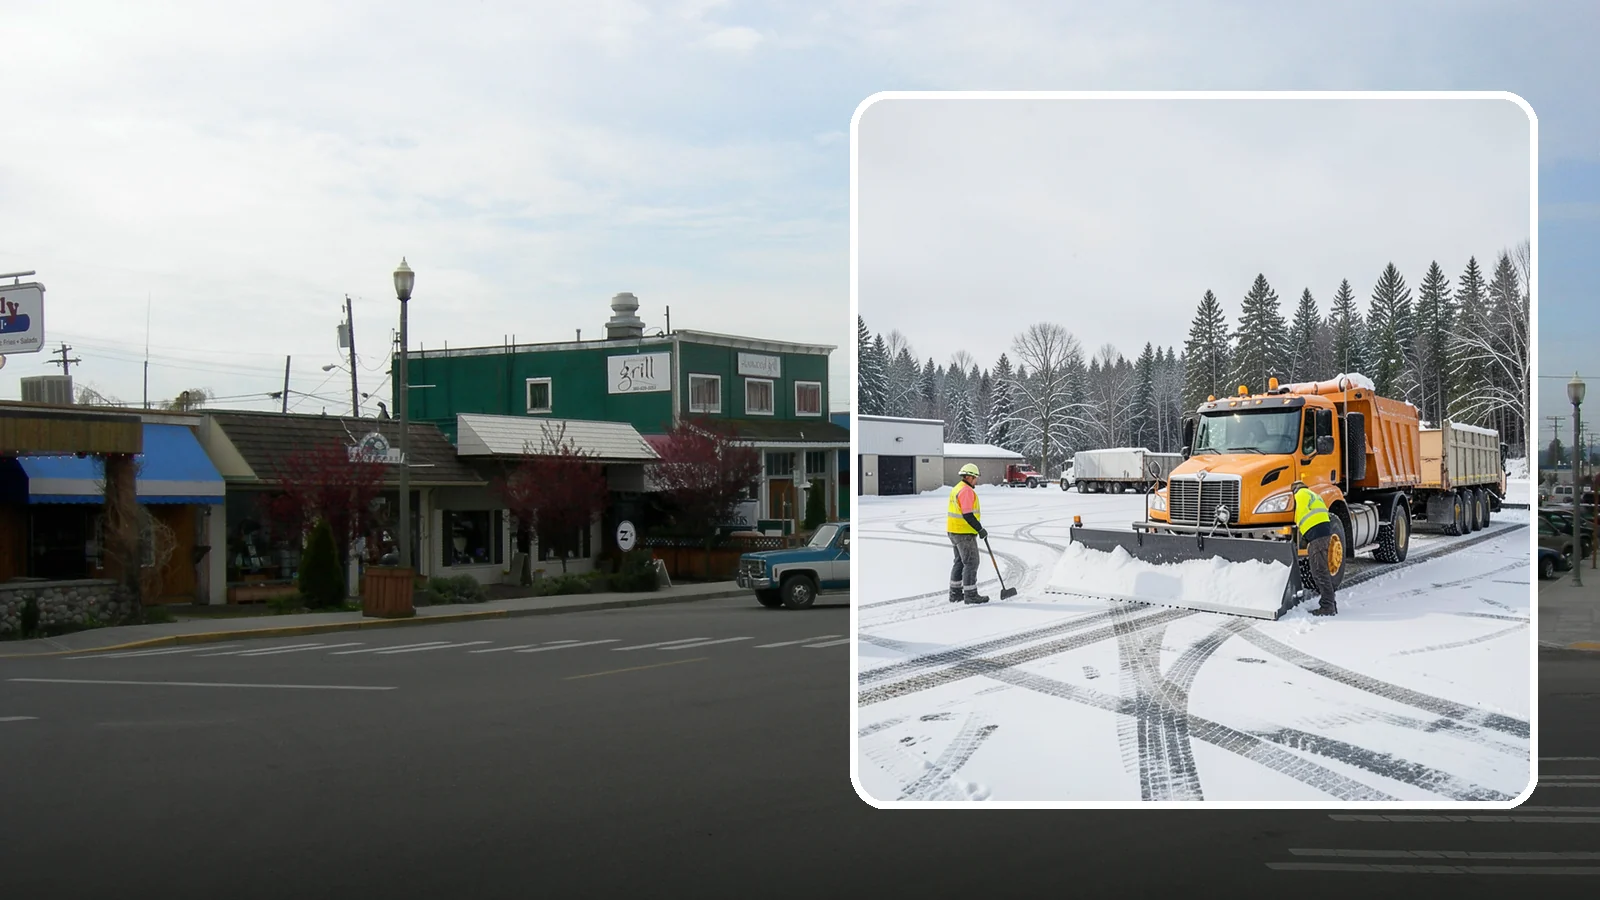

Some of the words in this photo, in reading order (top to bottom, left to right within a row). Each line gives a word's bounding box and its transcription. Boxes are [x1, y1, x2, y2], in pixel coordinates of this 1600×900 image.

[3, 338, 16, 346] Fries
[20, 337, 38, 345] Salads
[617, 356, 655, 392] grill
